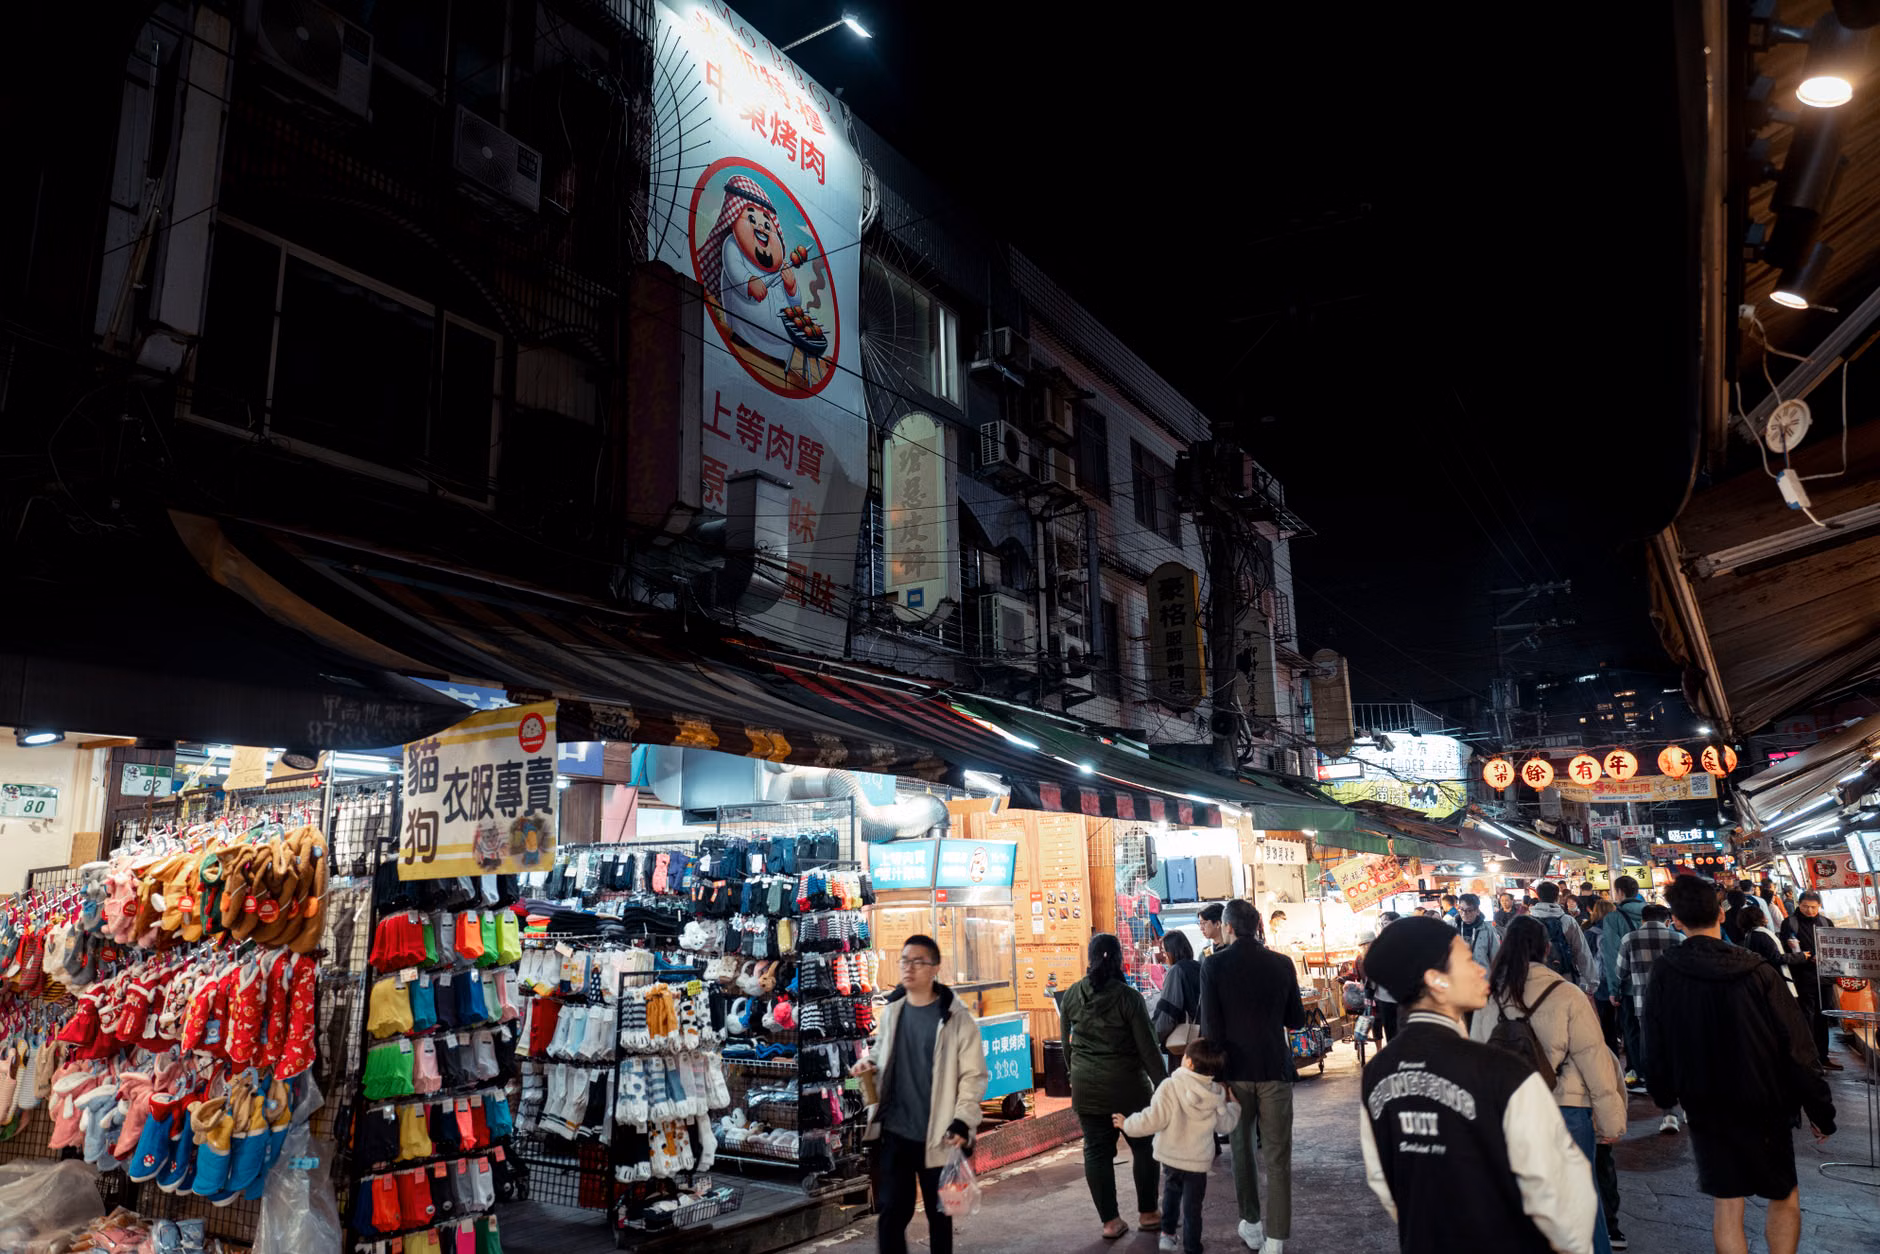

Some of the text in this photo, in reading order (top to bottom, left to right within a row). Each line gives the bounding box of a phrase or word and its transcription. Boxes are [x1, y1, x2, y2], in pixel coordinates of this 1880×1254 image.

[702, 389, 825, 485] 上等肉質
[1525, 764, 1547, 781] 餘
[1575, 761, 1593, 779] 有
[1608, 755, 1628, 775] 年
[143, 779, 162, 792] 82
[443, 756, 553, 824] 衣服專賣
[23, 800, 45, 813] 80
[403, 739, 441, 865] 貓狗
[1599, 867, 1647, 882] 百香
[992, 1033, 1026, 1056] 中東烤肉
